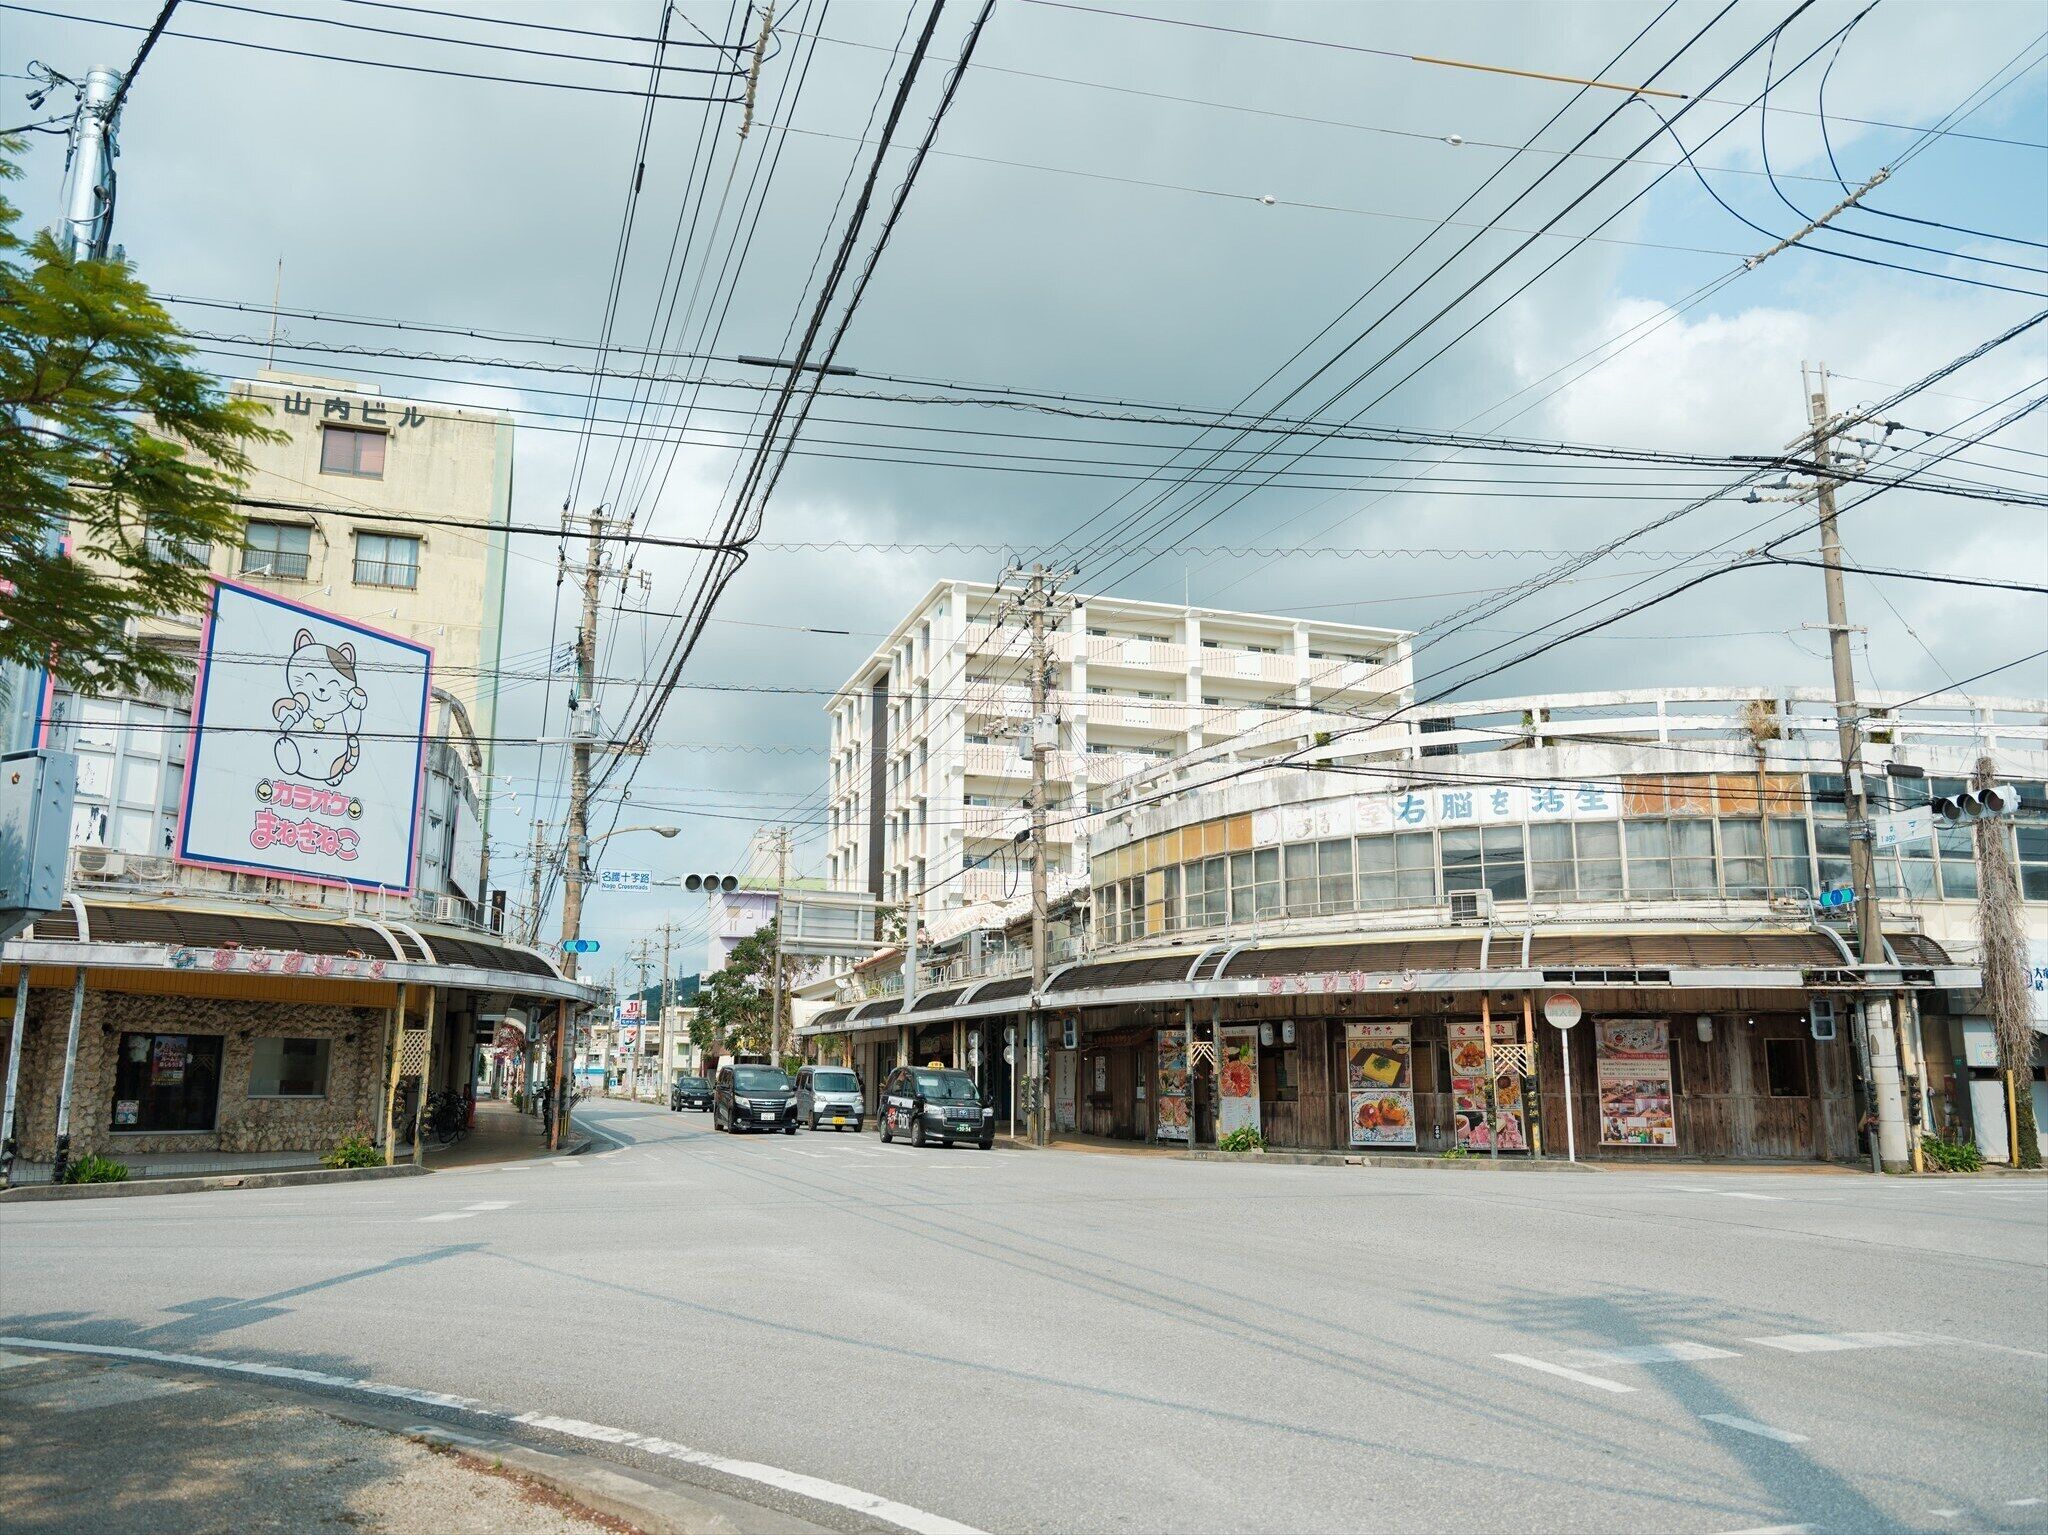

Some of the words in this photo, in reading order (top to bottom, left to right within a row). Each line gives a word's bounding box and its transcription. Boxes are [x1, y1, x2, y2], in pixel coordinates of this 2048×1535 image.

[284, 391, 426, 428] 山内ビル
[270, 780, 350, 816] カラオケ
[1396, 782, 1609, 826] 右脳を活生
[250, 808, 360, 861] まねきねこ
[602, 871, 650, 884] 名護十字路
